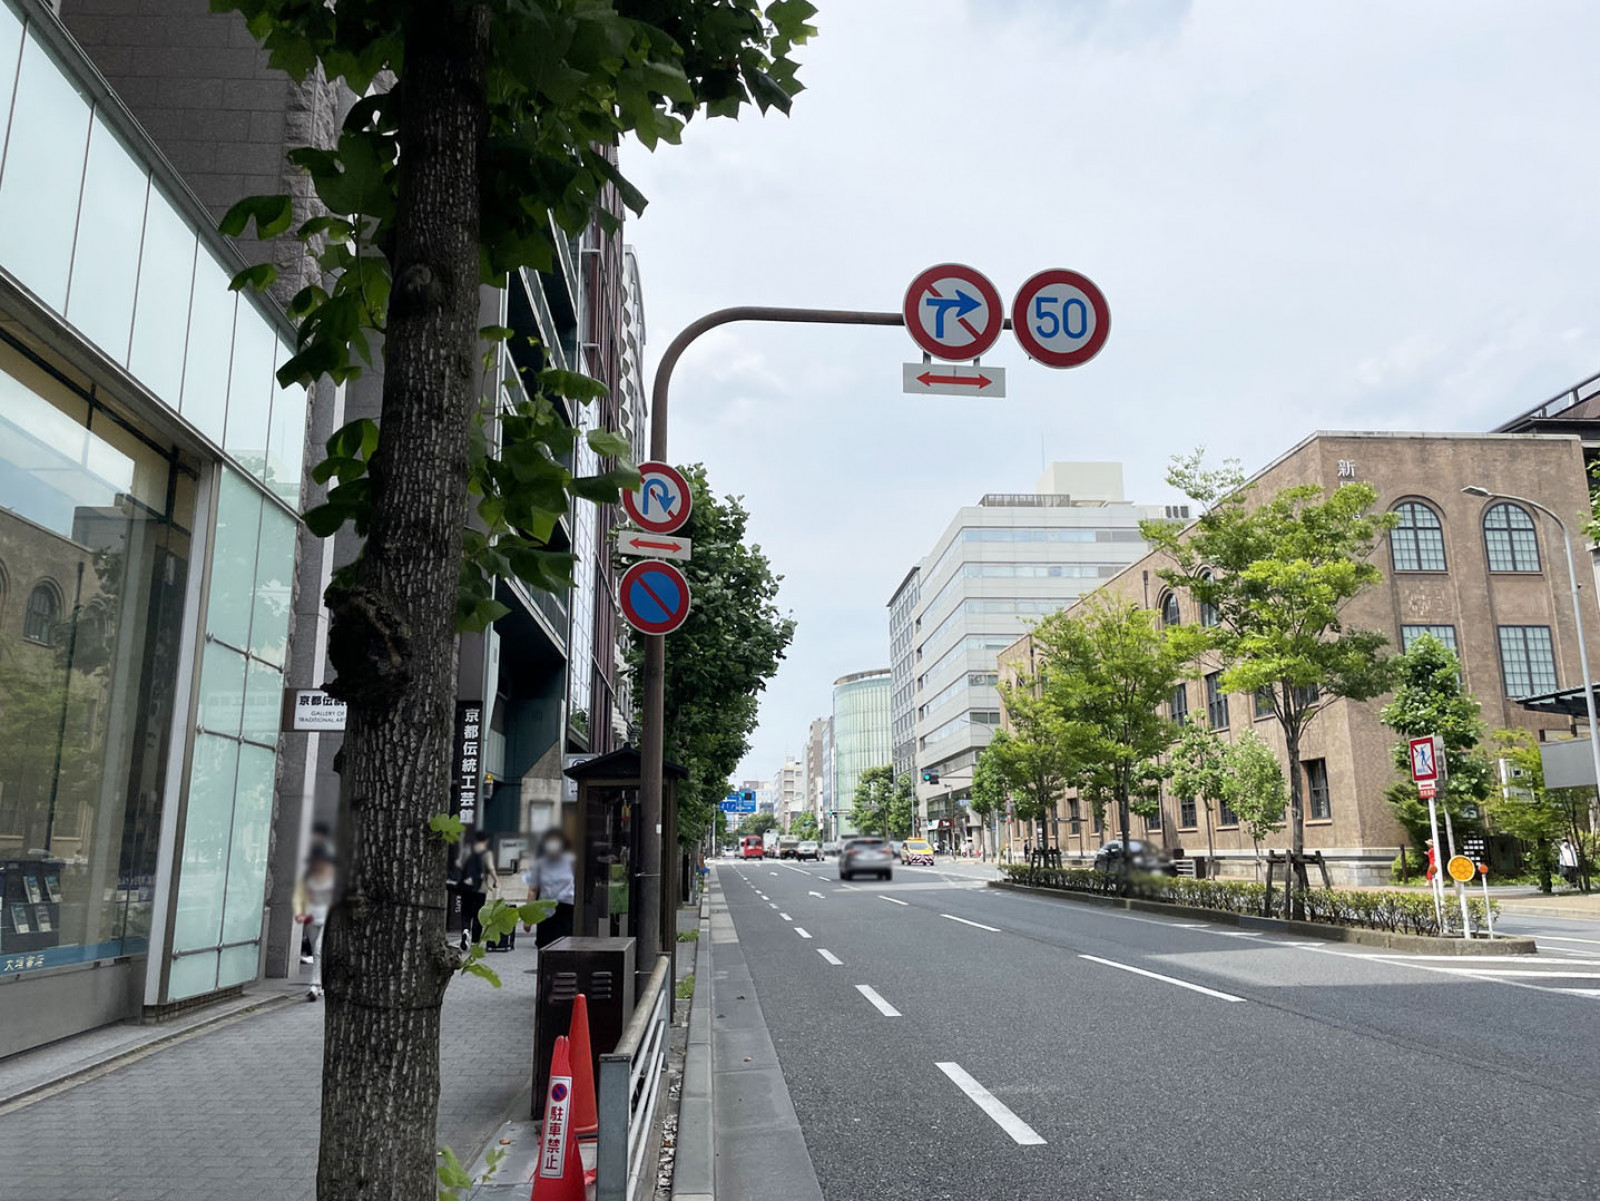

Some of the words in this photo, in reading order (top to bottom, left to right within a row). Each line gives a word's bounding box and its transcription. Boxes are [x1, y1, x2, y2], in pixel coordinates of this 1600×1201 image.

[1036, 297, 1087, 339] 50
[459, 708, 480, 824] 京都伝統工芸館
[545, 1106, 564, 1170] 駐車禁止
